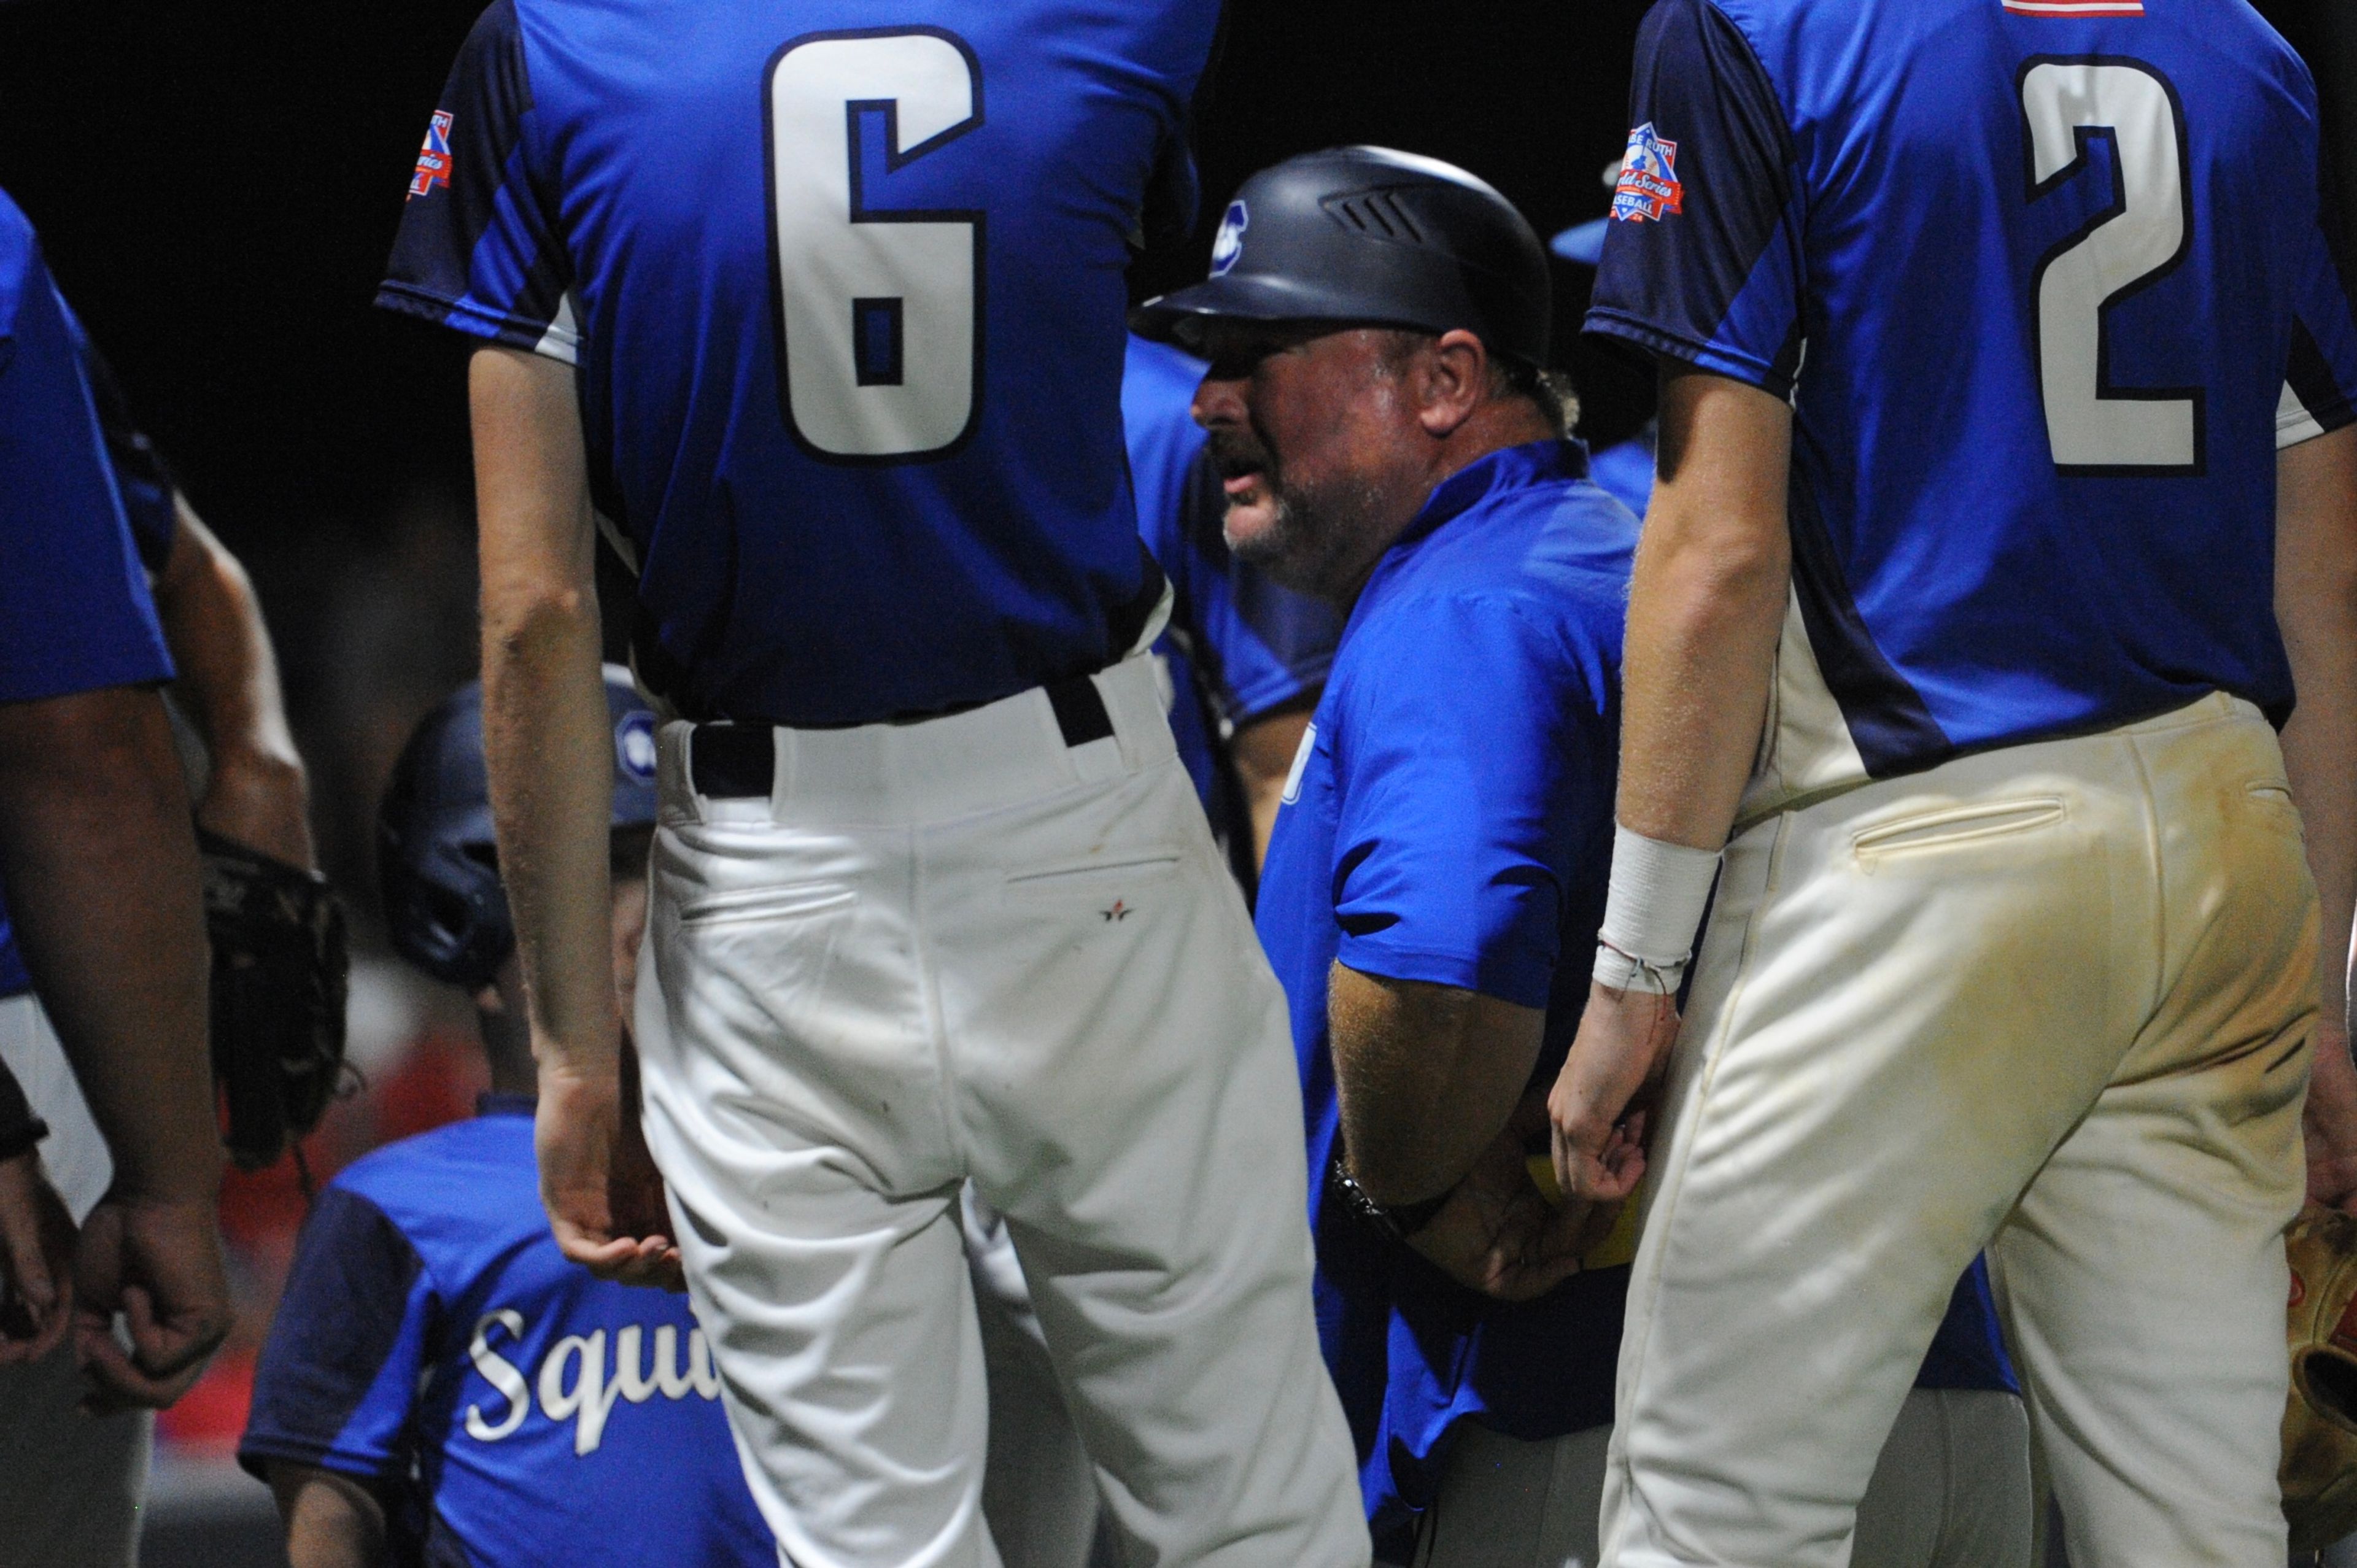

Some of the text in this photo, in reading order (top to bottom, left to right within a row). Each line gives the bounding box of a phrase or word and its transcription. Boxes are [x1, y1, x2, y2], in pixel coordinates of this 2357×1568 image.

[761, 25, 986, 468] 6
[1635, 174, 1672, 198] Series
[1646, 138, 1673, 156] RUTH
[2015, 53, 2206, 477] 2
